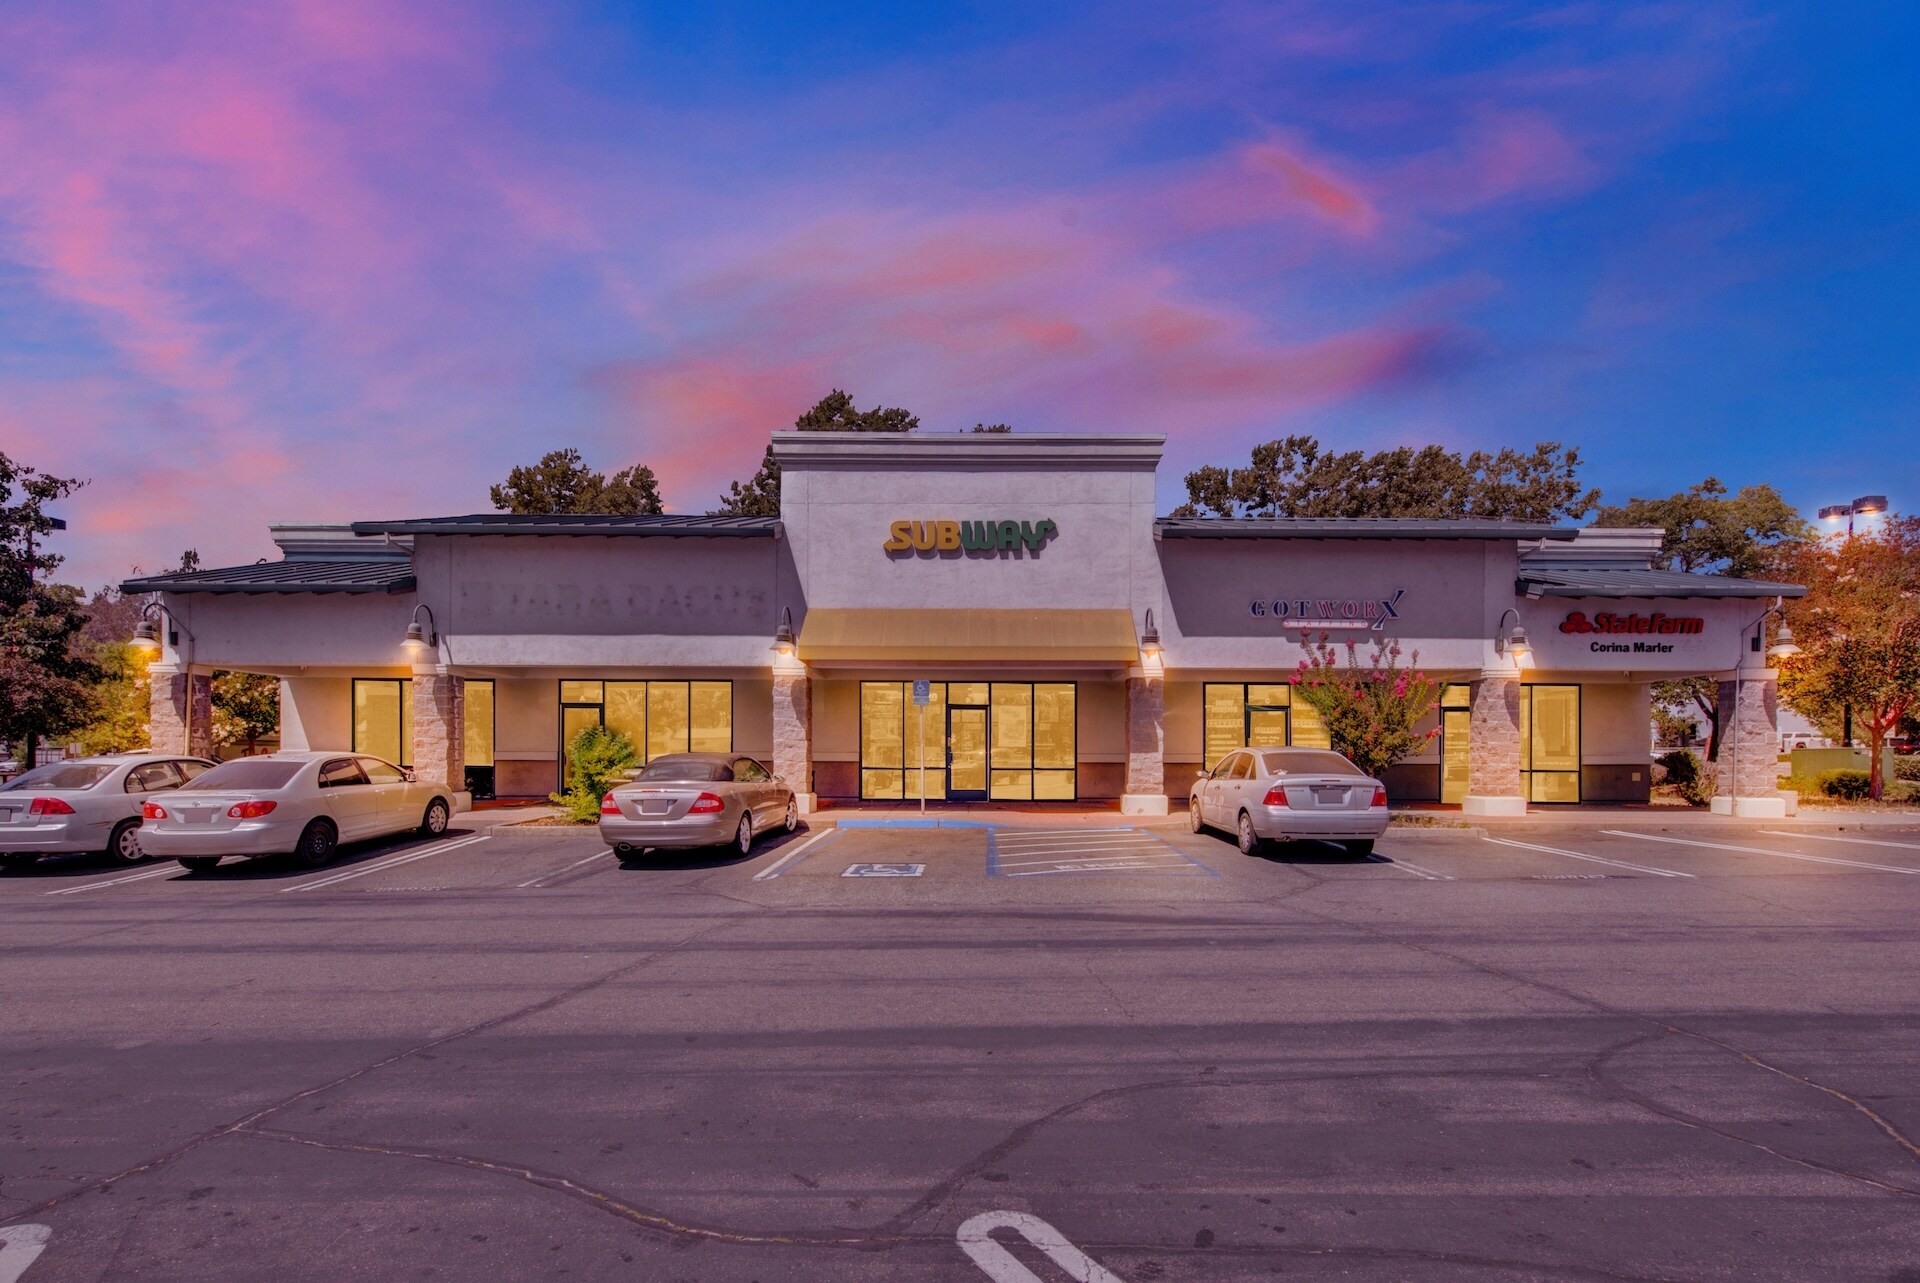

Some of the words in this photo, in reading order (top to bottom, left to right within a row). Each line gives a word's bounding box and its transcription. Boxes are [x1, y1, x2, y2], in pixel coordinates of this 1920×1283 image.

[883, 518, 1057, 552] SUBWAY
[1590, 641, 1630, 653] Corina
[1633, 641, 1674, 653] Marler
